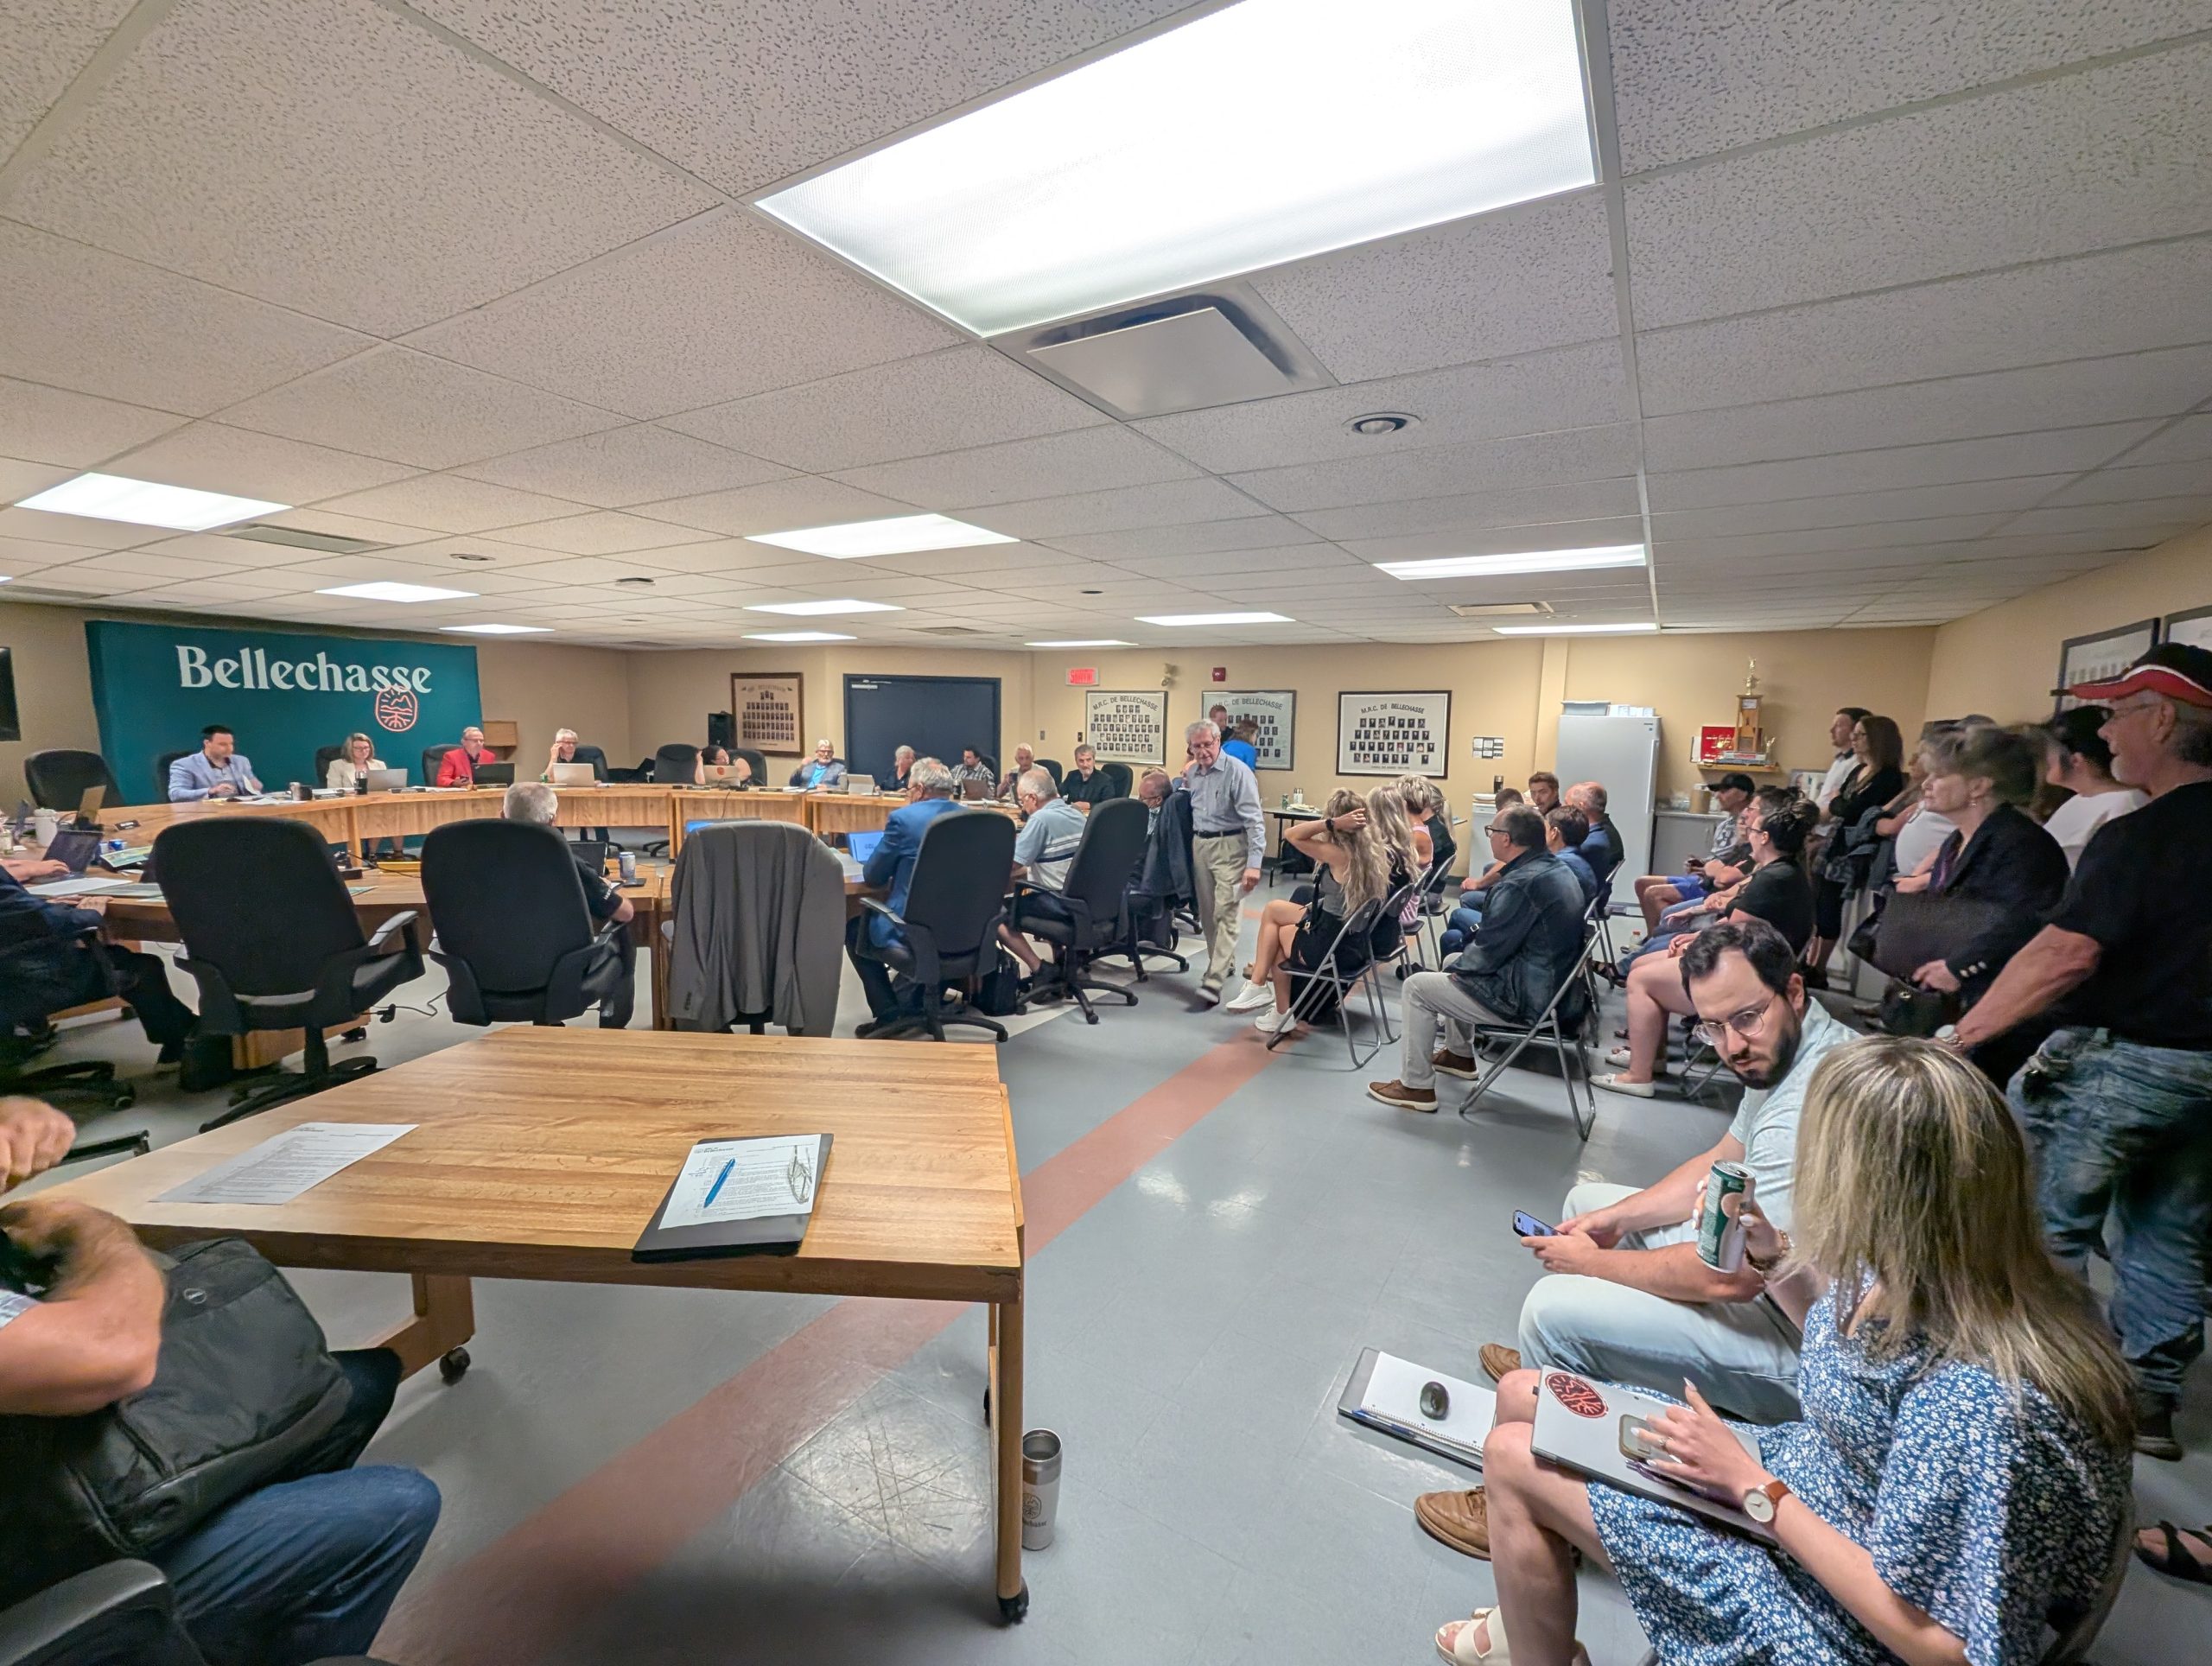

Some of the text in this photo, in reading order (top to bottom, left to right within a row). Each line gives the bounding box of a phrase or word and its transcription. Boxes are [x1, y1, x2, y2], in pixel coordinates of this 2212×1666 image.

[175, 645, 432, 693] Bellechasse
[1120, 696, 1159, 711] BELLECHASSE
[1242, 697, 1283, 710] BELLECHASSE
[1390, 703, 1425, 714] BELLECHASSE
